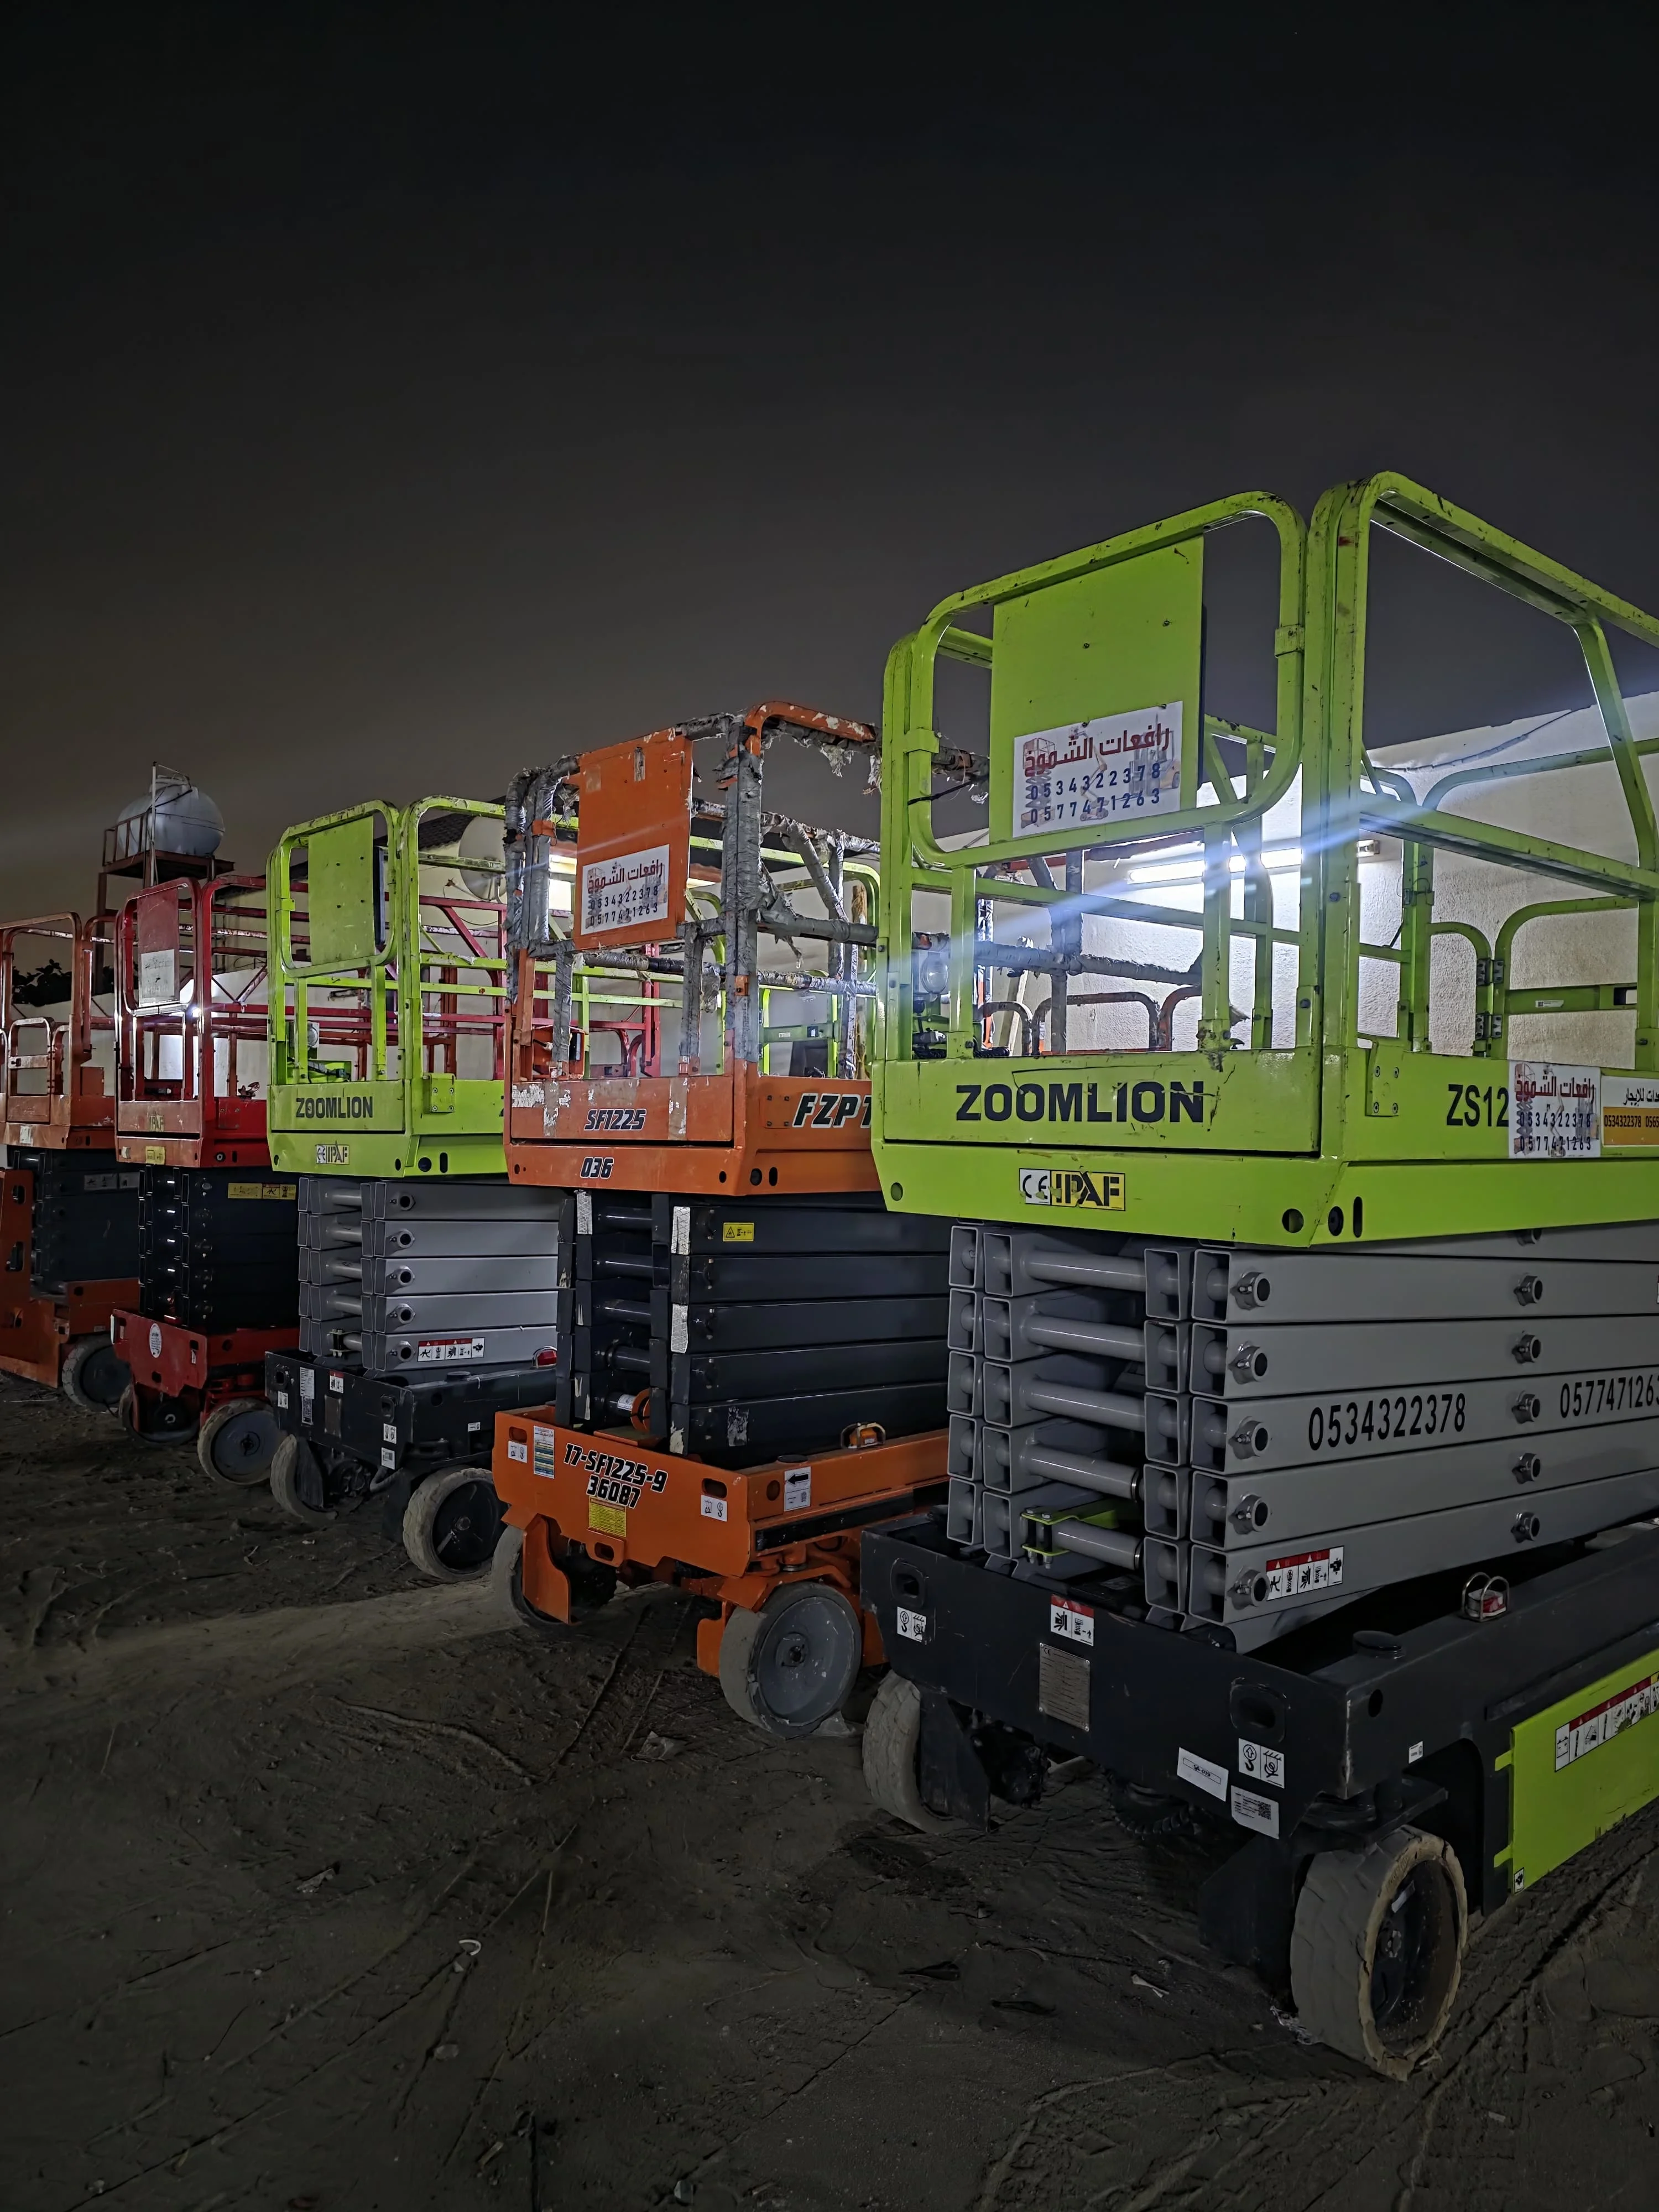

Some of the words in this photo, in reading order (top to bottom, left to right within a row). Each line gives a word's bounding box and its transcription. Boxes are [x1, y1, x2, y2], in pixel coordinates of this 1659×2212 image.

[1099, 723, 1170, 756] رافعات
[1025, 735, 1093, 777] الشموخ
[1031, 763, 1160, 800] 0534322378
[1031, 788, 1160, 823] 0577471263
[588, 867, 624, 894] الشموخ
[628, 859, 662, 880] رافعات
[590, 886, 658, 910] 0534322378
[590, 904, 658, 926] 0577471263
[1516, 1071, 1557, 1102] الشموخ
[1560, 1077, 1594, 1104] رافعات
[296, 1097, 373, 1118] ZOOMLION
[956, 1081, 1204, 1123] ZOOMLION
[1446, 1084, 1509, 1127] ZS12
[584, 1109, 646, 1131] SF1225
[1520, 1112, 1591, 1127] 0534322378
[1604, 1114, 1641, 1128] 0534322378
[328, 1144, 347, 1162] IPAF
[1520, 1136, 1591, 1151] 0577471263
[580, 1157, 614, 1179] 036
[1022, 1174, 1048, 1199] CE
[1055, 1171, 1120, 1207] IPAF
[1308, 1393, 1466, 1451] 0534322378
[564, 1443, 668, 1493] 17-SF1225-9
[586, 1474, 641, 1509] 36087
